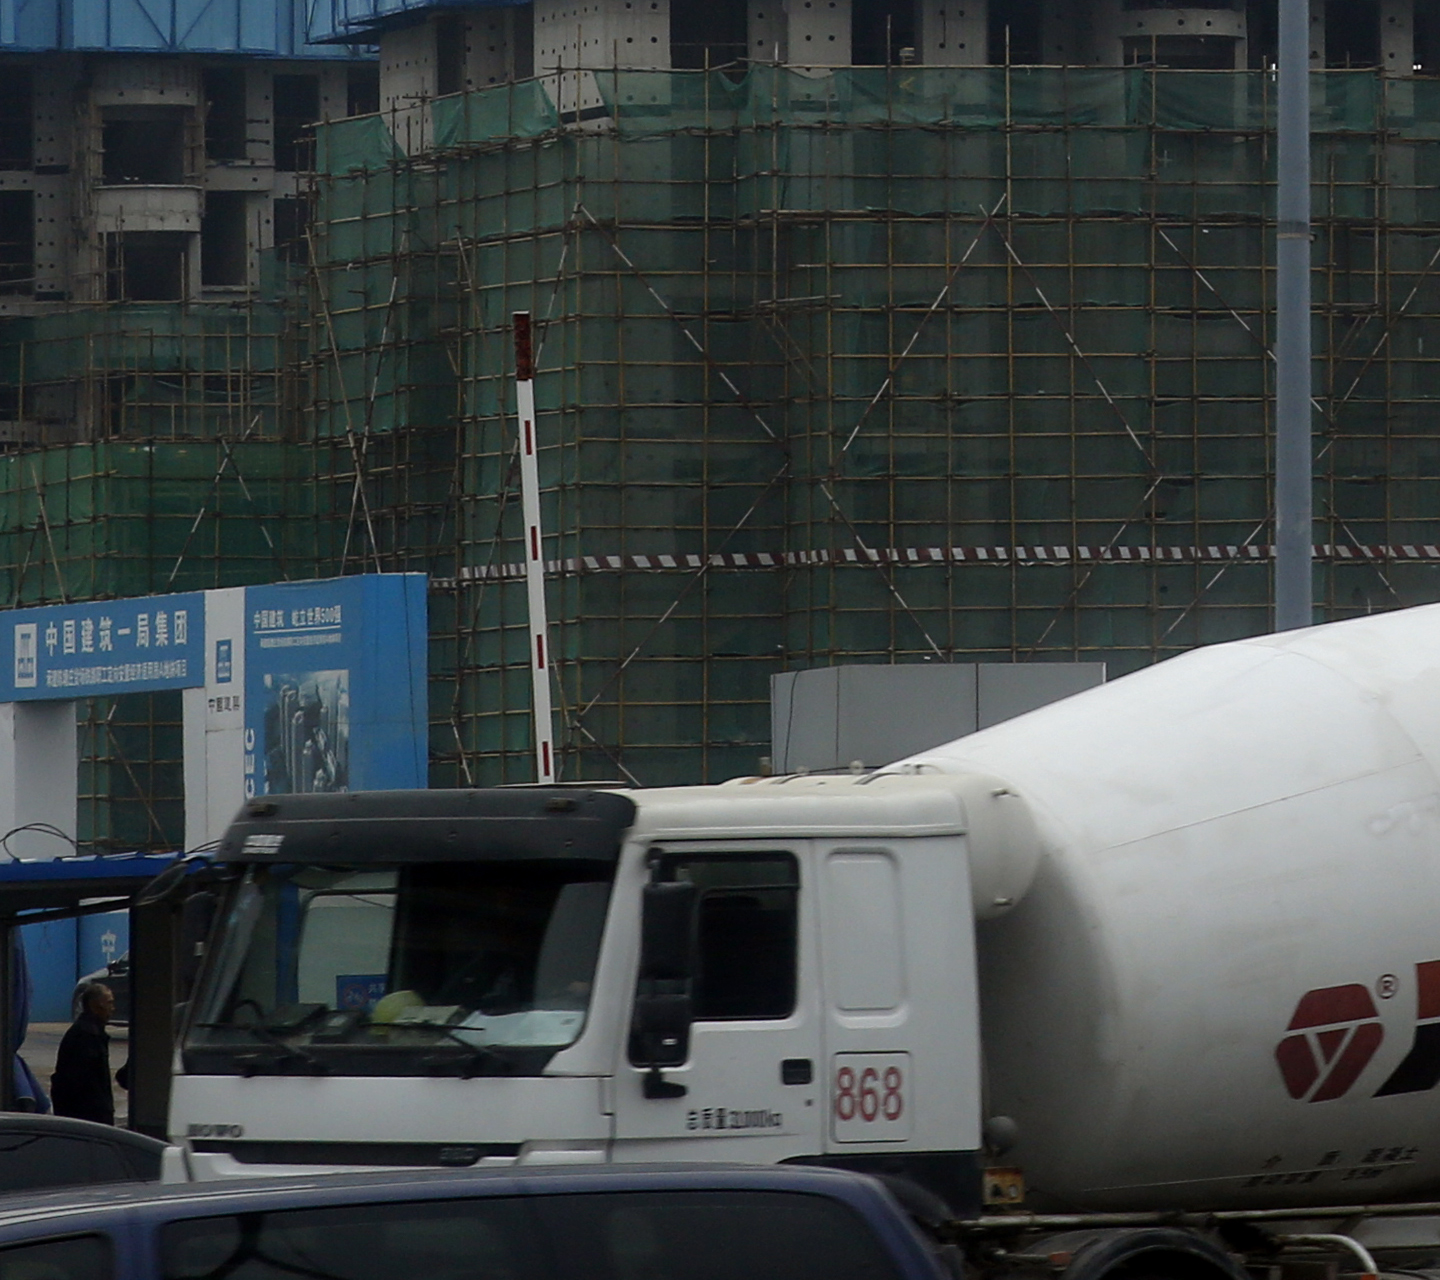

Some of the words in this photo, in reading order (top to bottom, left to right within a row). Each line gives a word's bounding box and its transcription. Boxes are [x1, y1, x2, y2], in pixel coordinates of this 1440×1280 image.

[45, 609, 188, 657] 中国建筑一局集团
[835, 1066, 904, 1122] 868
